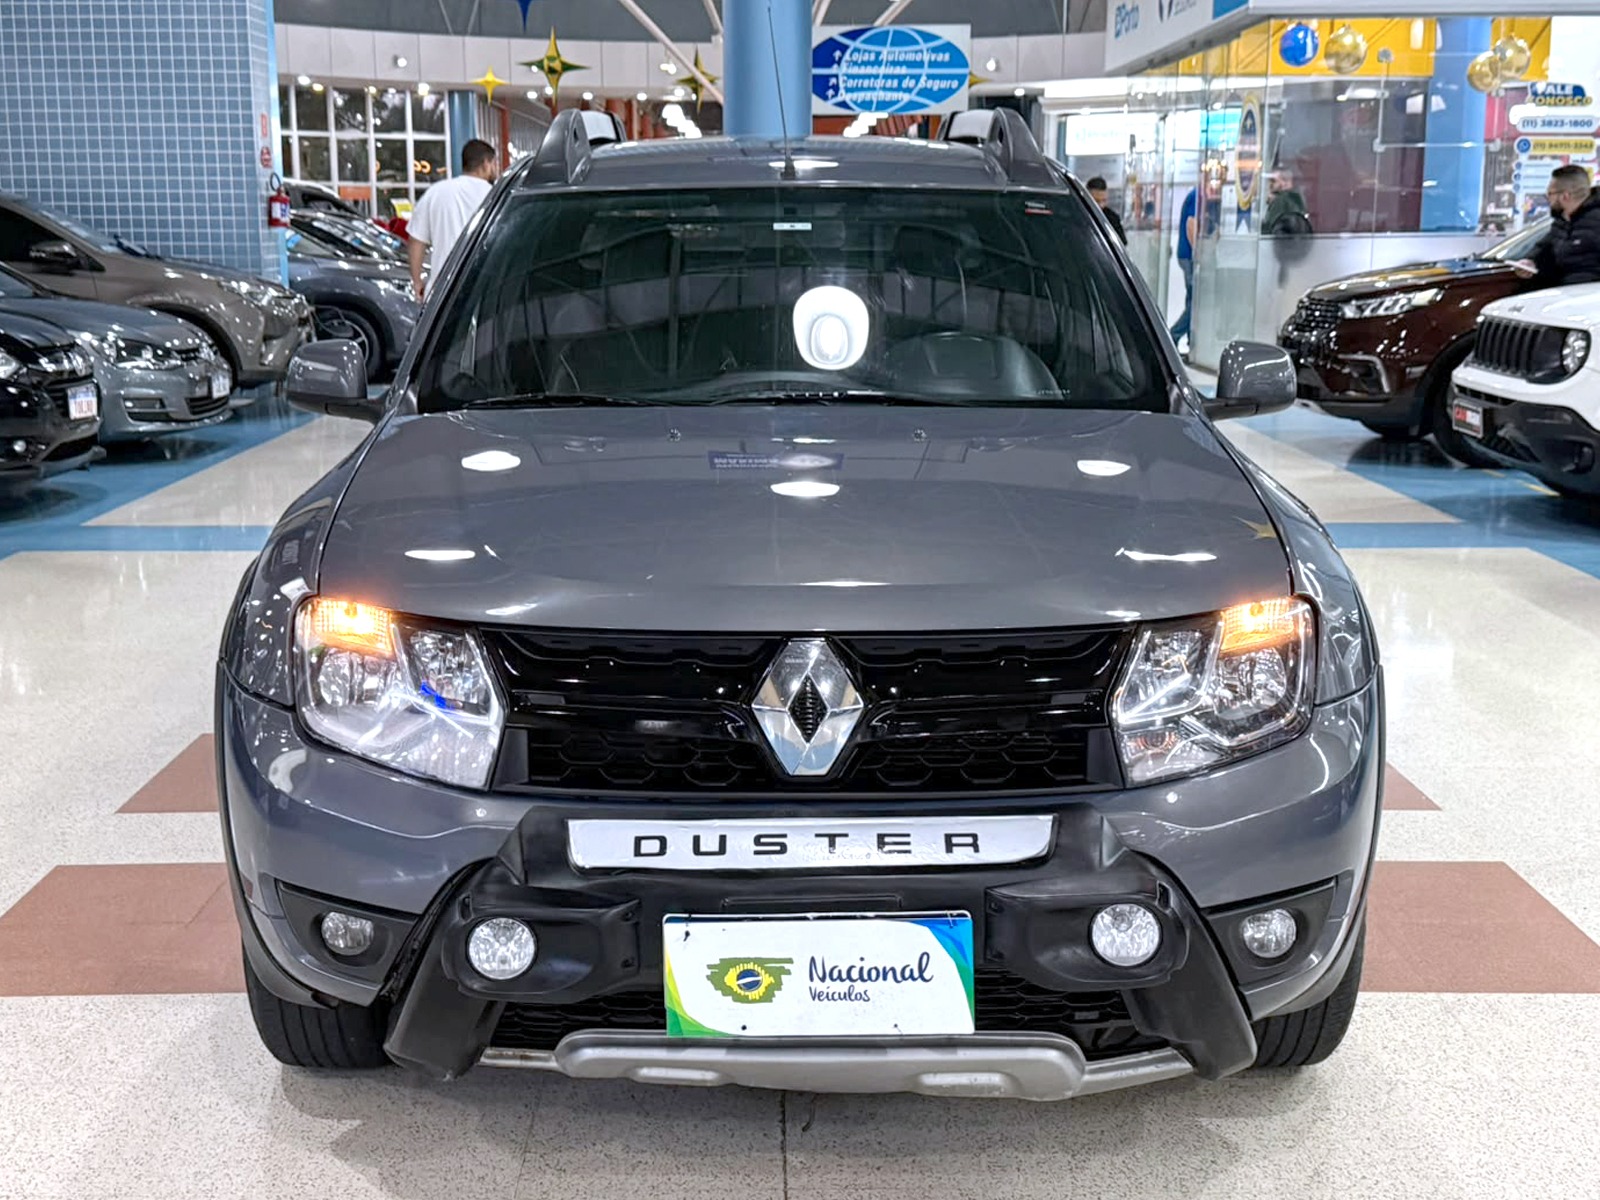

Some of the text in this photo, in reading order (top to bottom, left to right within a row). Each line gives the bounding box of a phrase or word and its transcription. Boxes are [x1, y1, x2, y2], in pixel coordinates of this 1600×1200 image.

[841, 76, 959, 91] Corretoras de Seguro
[633, 832, 980, 858] DUSTER
[809, 951, 934, 984] Nacional
[809, 984, 870, 1002] Veículos
